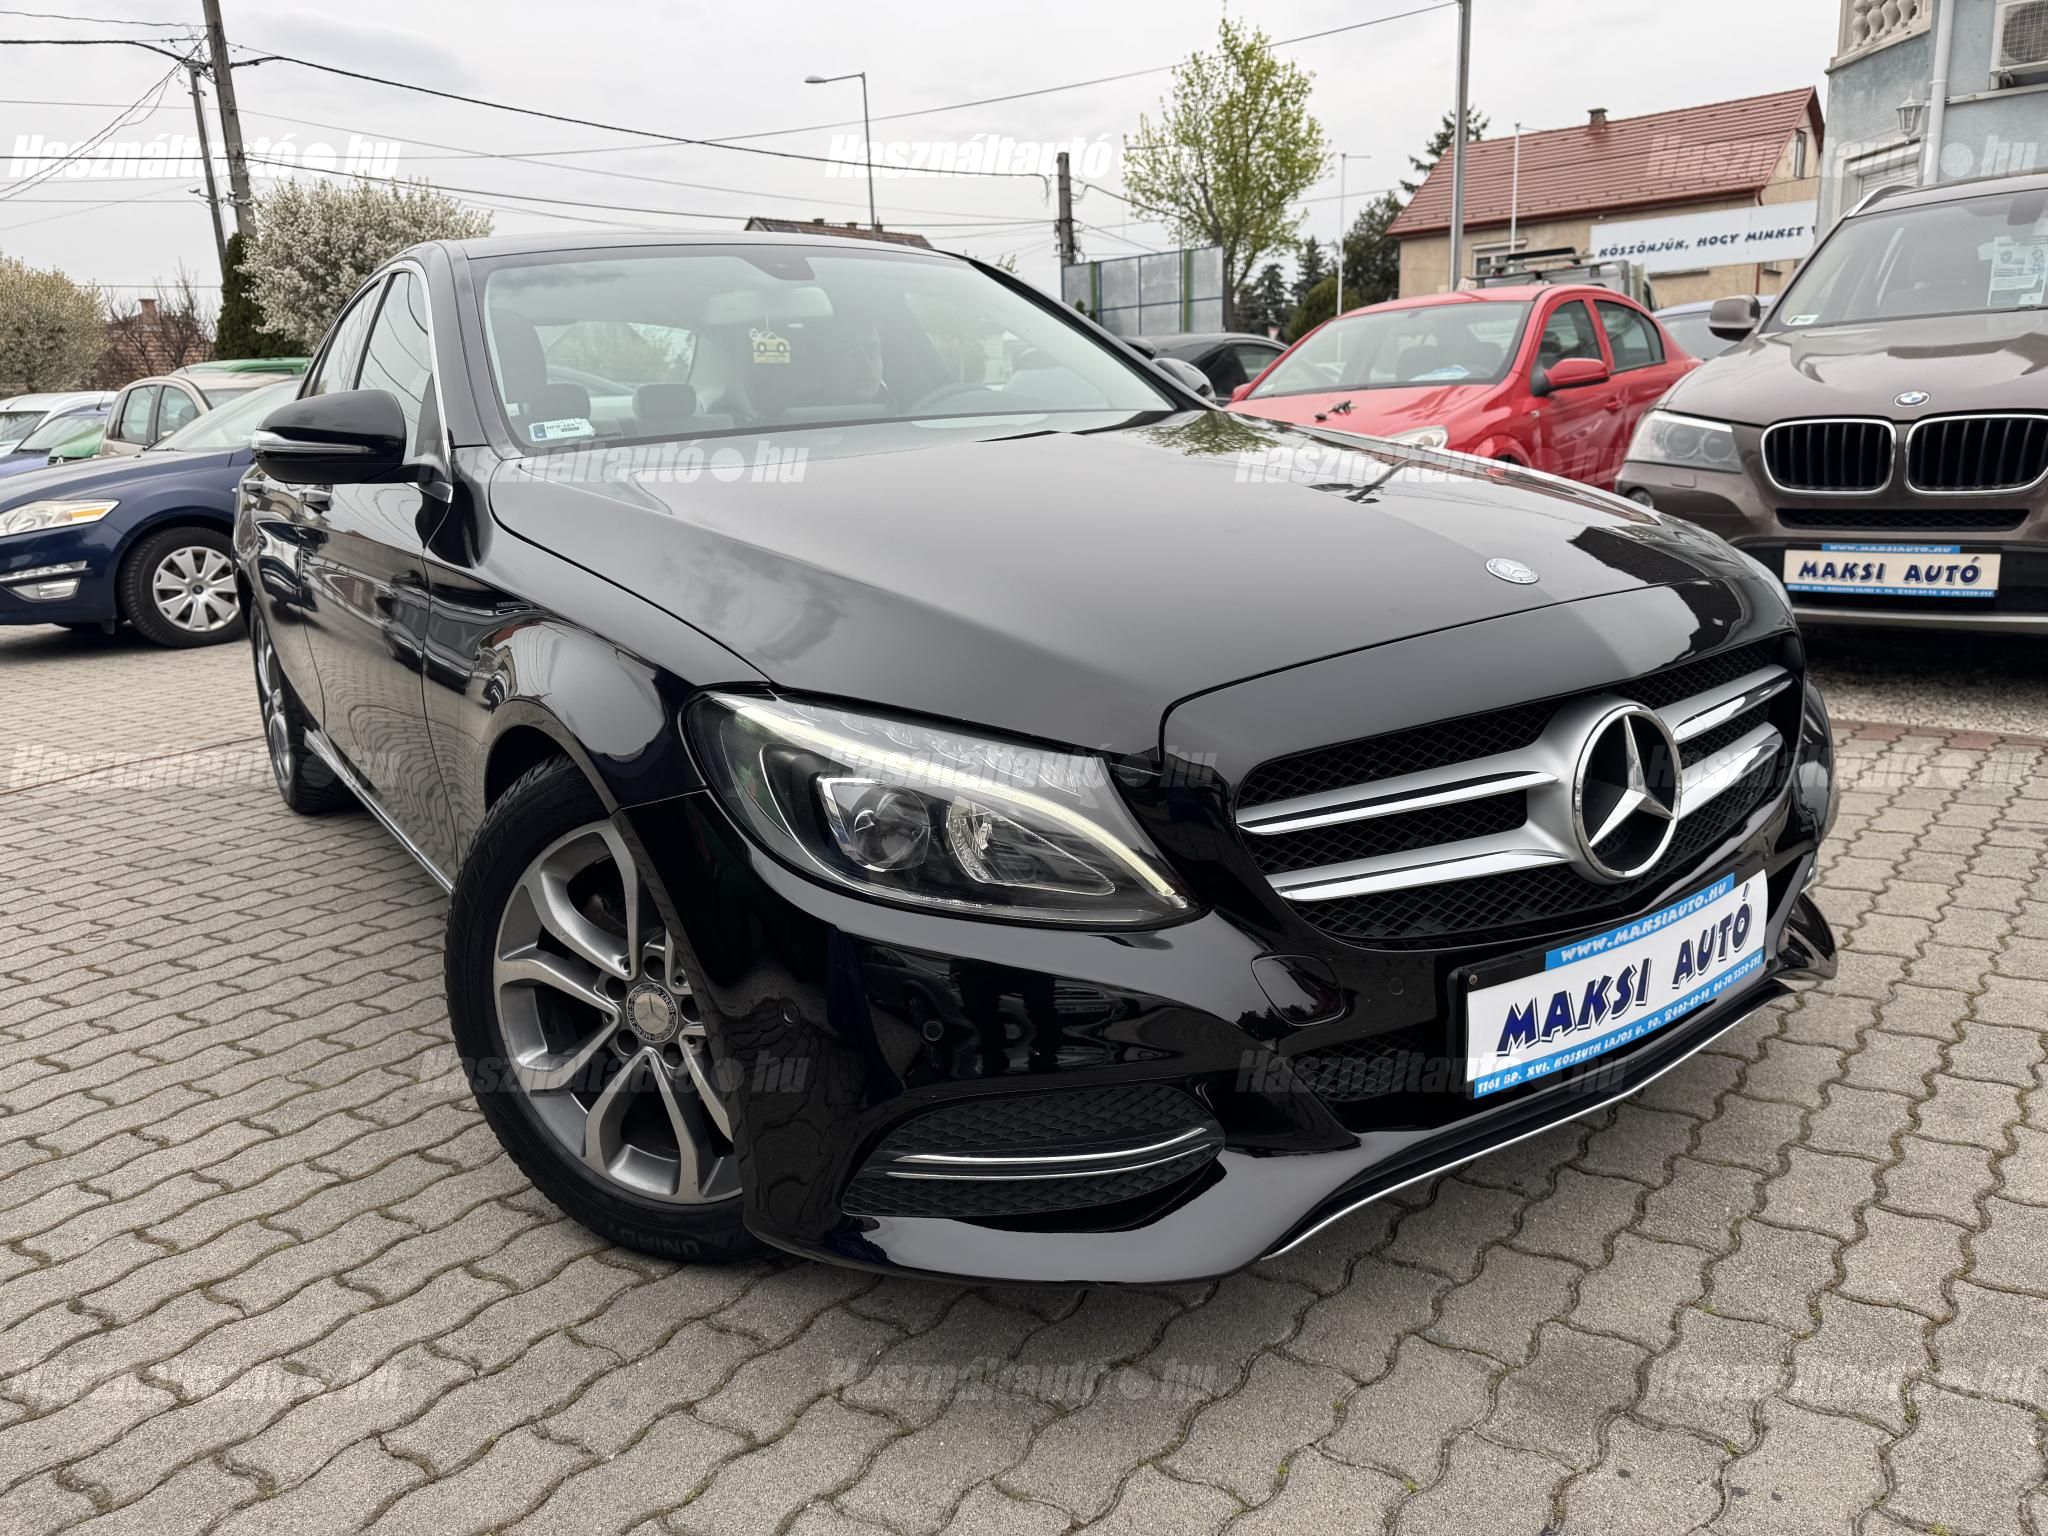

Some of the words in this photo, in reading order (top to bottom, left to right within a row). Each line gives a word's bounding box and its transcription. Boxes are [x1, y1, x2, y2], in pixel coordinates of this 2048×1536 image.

[1599, 237, 1689, 258] KÖSZÖNJÜK,
[1696, 232, 1740, 248] HOGY
[1744, 225, 1804, 243] MINKET
[1798, 560, 1887, 583] MAKSI
[1903, 556, 1982, 586] AUTÓ
[1496, 957, 1652, 1057] MAKSI
[1672, 882, 1752, 989] AUTÓ
[1526, 1060, 1550, 1079] XVI.
[1553, 1042, 1602, 1069] KOSSUTH
[1603, 1029, 1633, 1050] LAJOS
